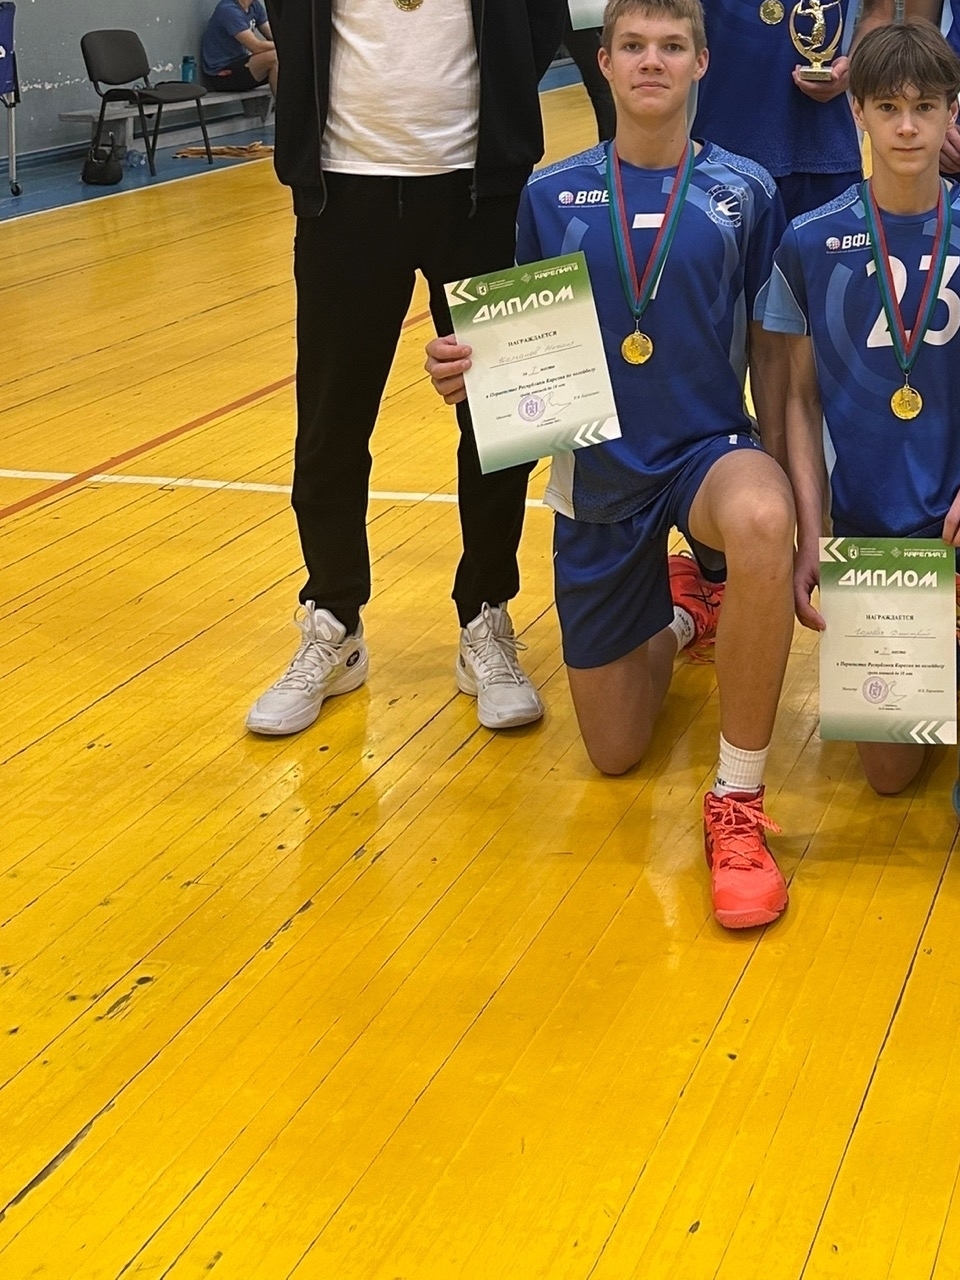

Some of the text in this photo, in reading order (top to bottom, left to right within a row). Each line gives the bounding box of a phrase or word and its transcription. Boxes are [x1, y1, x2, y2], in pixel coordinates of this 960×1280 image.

[472, 284, 575, 324] ДИПЛОМ
[508, 331, 557, 347] НАГРАЖДАЕТСЯ
[838, 569, 937, 588] ДИПЛОМ
